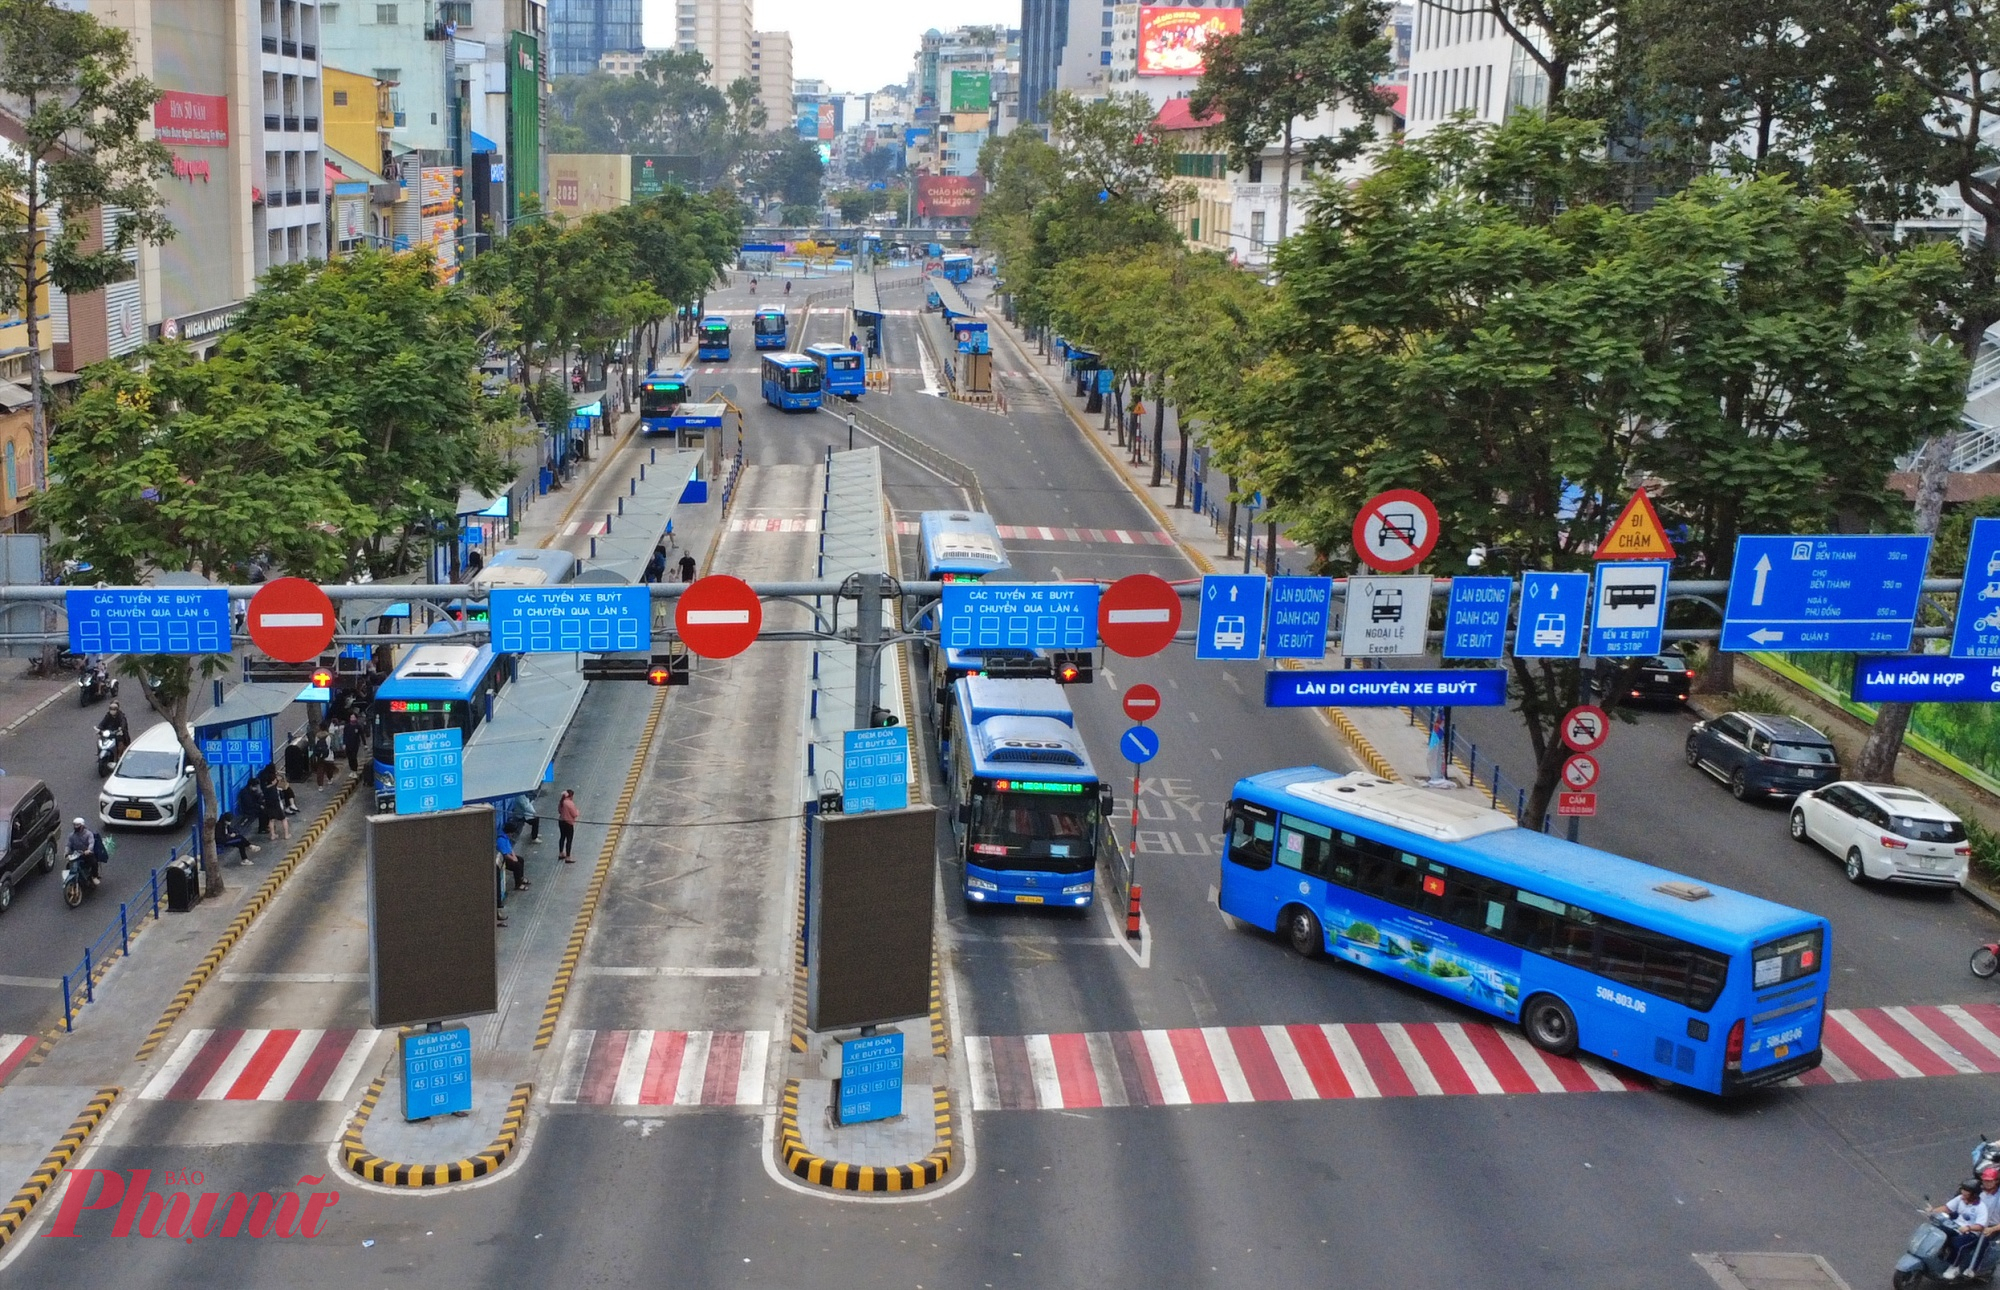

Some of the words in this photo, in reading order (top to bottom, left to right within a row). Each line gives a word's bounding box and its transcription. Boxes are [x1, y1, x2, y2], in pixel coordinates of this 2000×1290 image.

[185, 315, 225, 339] HIGHLANDS
[1631, 514, 1643, 527] ĐI
[1618, 531, 1651, 551] CHẬM
[1817, 541, 1828, 549] GA
[1815, 549, 1830, 560] BẾN
[1832, 549, 1857, 560] THÀNH
[1812, 569, 1828, 578] CHỢ
[1810, 579, 1825, 589] BẾN
[1827, 579, 1851, 589] THÀNH
[1882, 581, 1895, 589] 350
[94, 594, 114, 604] CÁC
[119, 592, 151, 604] TUYẾN
[157, 596, 170, 604] XE
[176, 594, 202, 604] BUÝT
[518, 593, 537, 603] CÁC
[542, 591, 574, 603] TUYẾN
[579, 593, 592, 603] XE
[597, 592, 622, 602] BUÝT
[969, 589, 988, 600] CÁC
[994, 588, 1026, 600] TUYẾN
[1031, 591, 1044, 600] XE
[1049, 589, 1075, 600] BUÝT
[1275, 584, 1294, 603] LÀN
[1295, 585, 1325, 603] ĐƯỜNG
[1455, 584, 1474, 603] LÀN
[1475, 584, 1505, 603] ĐƯỜNG
[106, 605, 146, 618] CHUYỂN
[151, 608, 171, 618] QUA
[177, 607, 198, 617] LÀN
[203, 608, 209, 617] 6
[527, 604, 565, 617] CHUYỂN
[571, 607, 590, 616] QUA
[597, 605, 618, 615] LÀN
[622, 607, 628, 615] 5
[979, 601, 1017, 613] CHUYỂN
[1023, 605, 1043, 613] QUA
[1050, 602, 1070, 613] LÀN
[1073, 605, 1079, 613] 4
[1276, 607, 1301, 625] DÀNH
[1301, 611, 1320, 625] CHO
[1455, 607, 1479, 625] DÀNH
[1481, 611, 1500, 625] CHO
[1365, 628, 1391, 640] NGOẠI
[1394, 625, 1405, 640] LỆ
[1619, 630, 1629, 639] XE
[1631, 629, 1649, 639] BUÝT
[1800, 631, 1823, 643] QUẬN
[1823, 632, 1829, 641] 5
[1277, 634, 1290, 648] XE
[1290, 630, 1314, 648] BUÝT
[1456, 633, 1469, 648] XE
[1469, 630, 1493, 648] BUÝT
[1978, 635, 1988, 644] XE
[1989, 635, 1999, 644] 02
[1368, 643, 1398, 654] Except
[1607, 642, 1621, 651] BUS
[1623, 642, 1643, 651] STOP
[1976, 647, 1987, 656] 03
[1866, 670, 1896, 685] LÀN
[1898, 671, 1930, 685] HỖN
[1933, 673, 1965, 687] HỢP
[1296, 681, 1326, 695] LÀN
[1330, 684, 1345, 695] DI
[1413, 683, 1433, 694] XE
[1437, 680, 1477, 694] BUÝT
[229, 742, 240, 750] 20
[403, 759, 414, 768] 01
[423, 756, 434, 766] 03
[443, 754, 454, 764] 19
[879, 756, 887, 764] 31
[403, 778, 415, 788] 45
[423, 776, 434, 786] 53
[443, 774, 454, 784] 56
[847, 780, 856, 788] 44
[1126, 776, 1201, 798] XE
[414, 1048, 425, 1056] XE
[850, 1053, 860, 1061] XE
[414, 1063, 424, 1073] 01
[433, 1059, 444, 1069] 03
[453, 1055, 463, 1065] 19
[875, 1061, 883, 1070] 31
[414, 1080, 425, 1089] 45
[434, 1076, 445, 1086] 53
[453, 1072, 464, 1082] 56
[846, 1087, 854, 1095] 44
